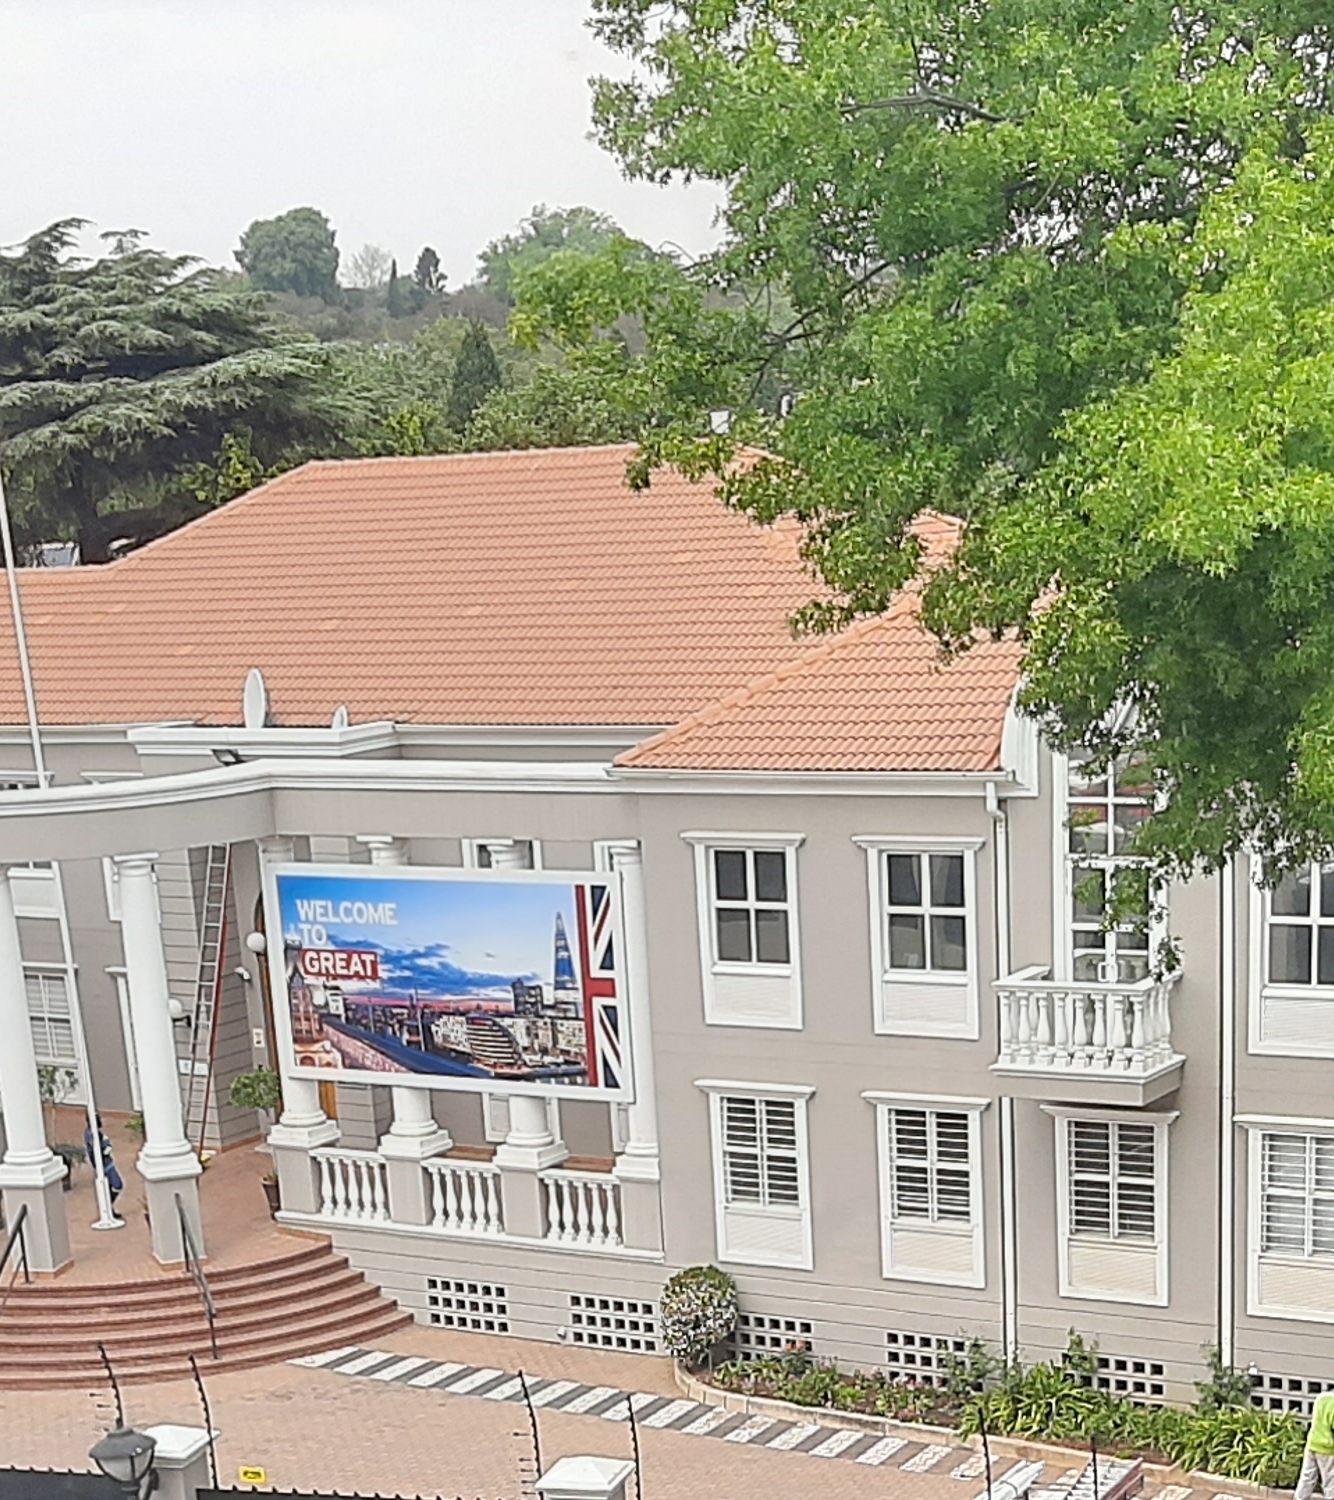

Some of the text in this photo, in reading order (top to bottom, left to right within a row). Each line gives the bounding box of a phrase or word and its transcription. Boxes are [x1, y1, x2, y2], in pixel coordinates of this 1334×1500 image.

[295, 899, 398, 925] WELCOME
[298, 923, 327, 946] TO
[304, 951, 375, 977] GREAT
